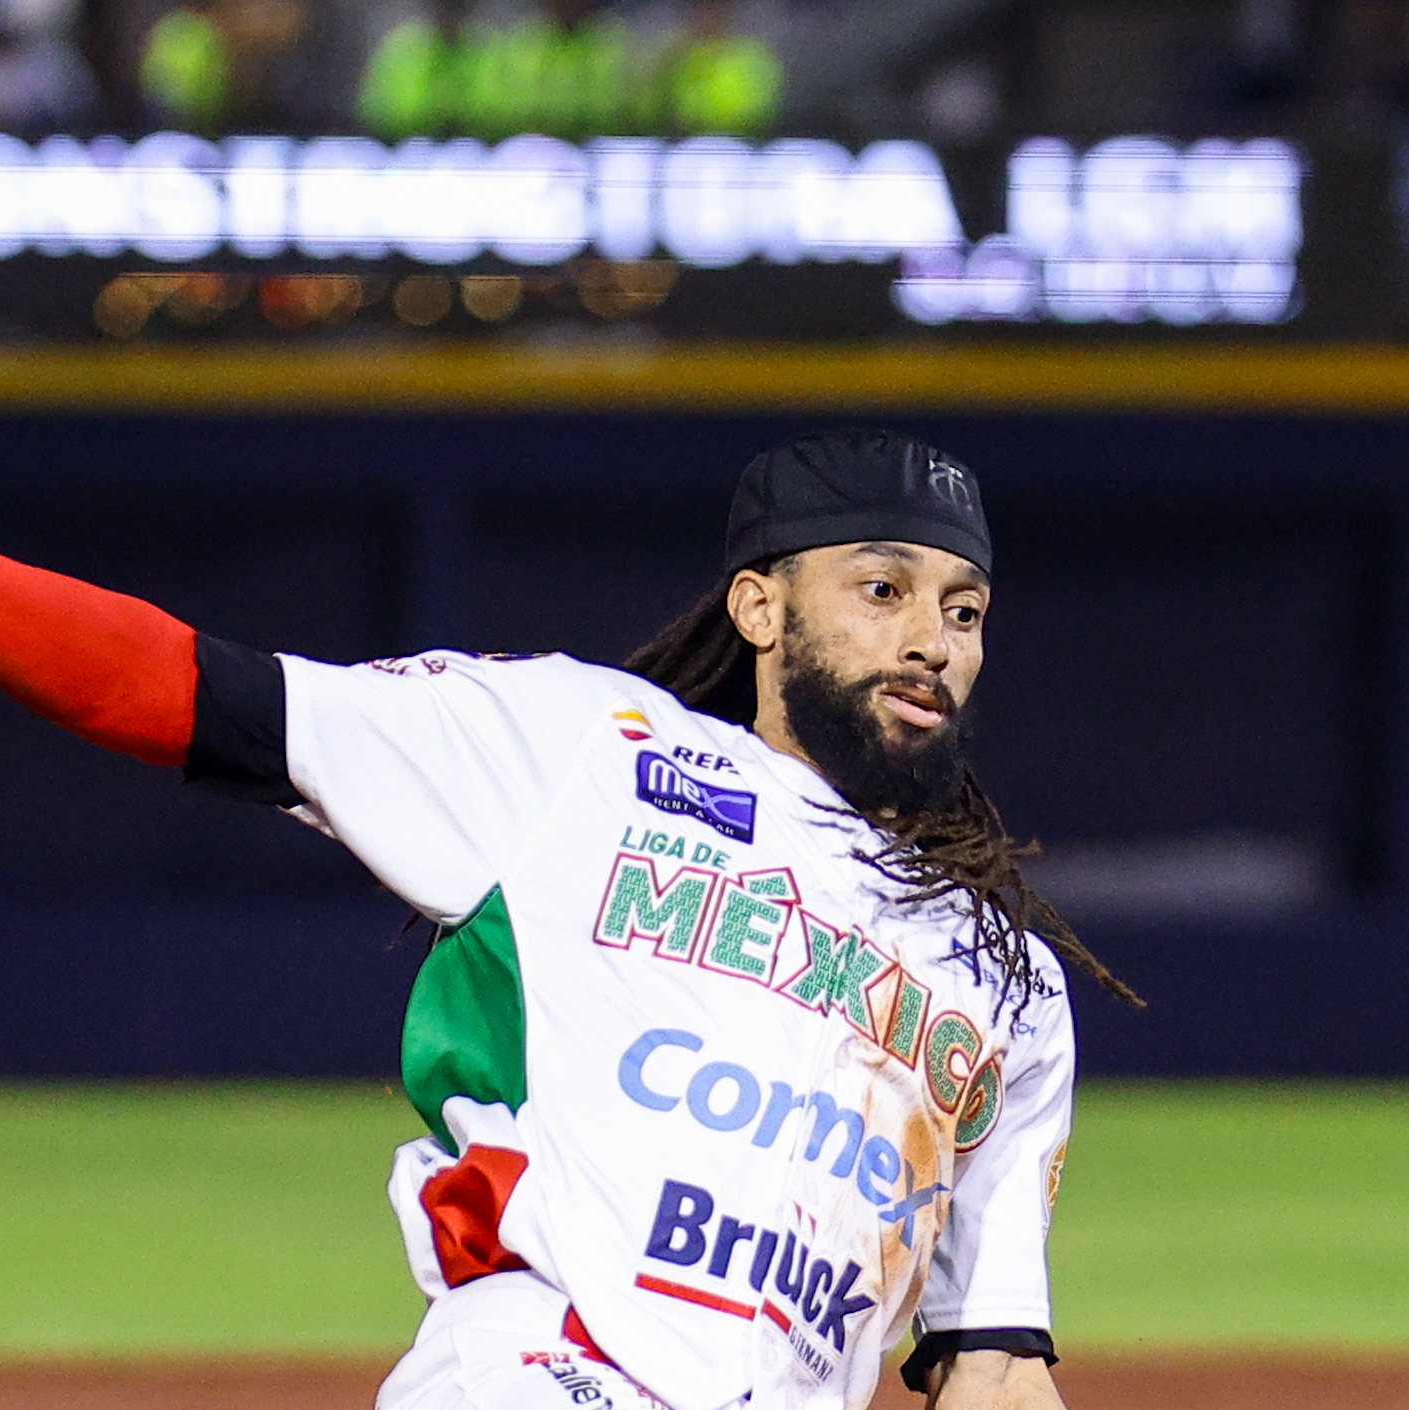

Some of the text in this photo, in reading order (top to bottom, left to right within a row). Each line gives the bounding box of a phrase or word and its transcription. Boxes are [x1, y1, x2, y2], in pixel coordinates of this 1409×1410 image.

[620, 825, 732, 871] LIGA DE
[593, 852, 1004, 1154] MÉXICO
